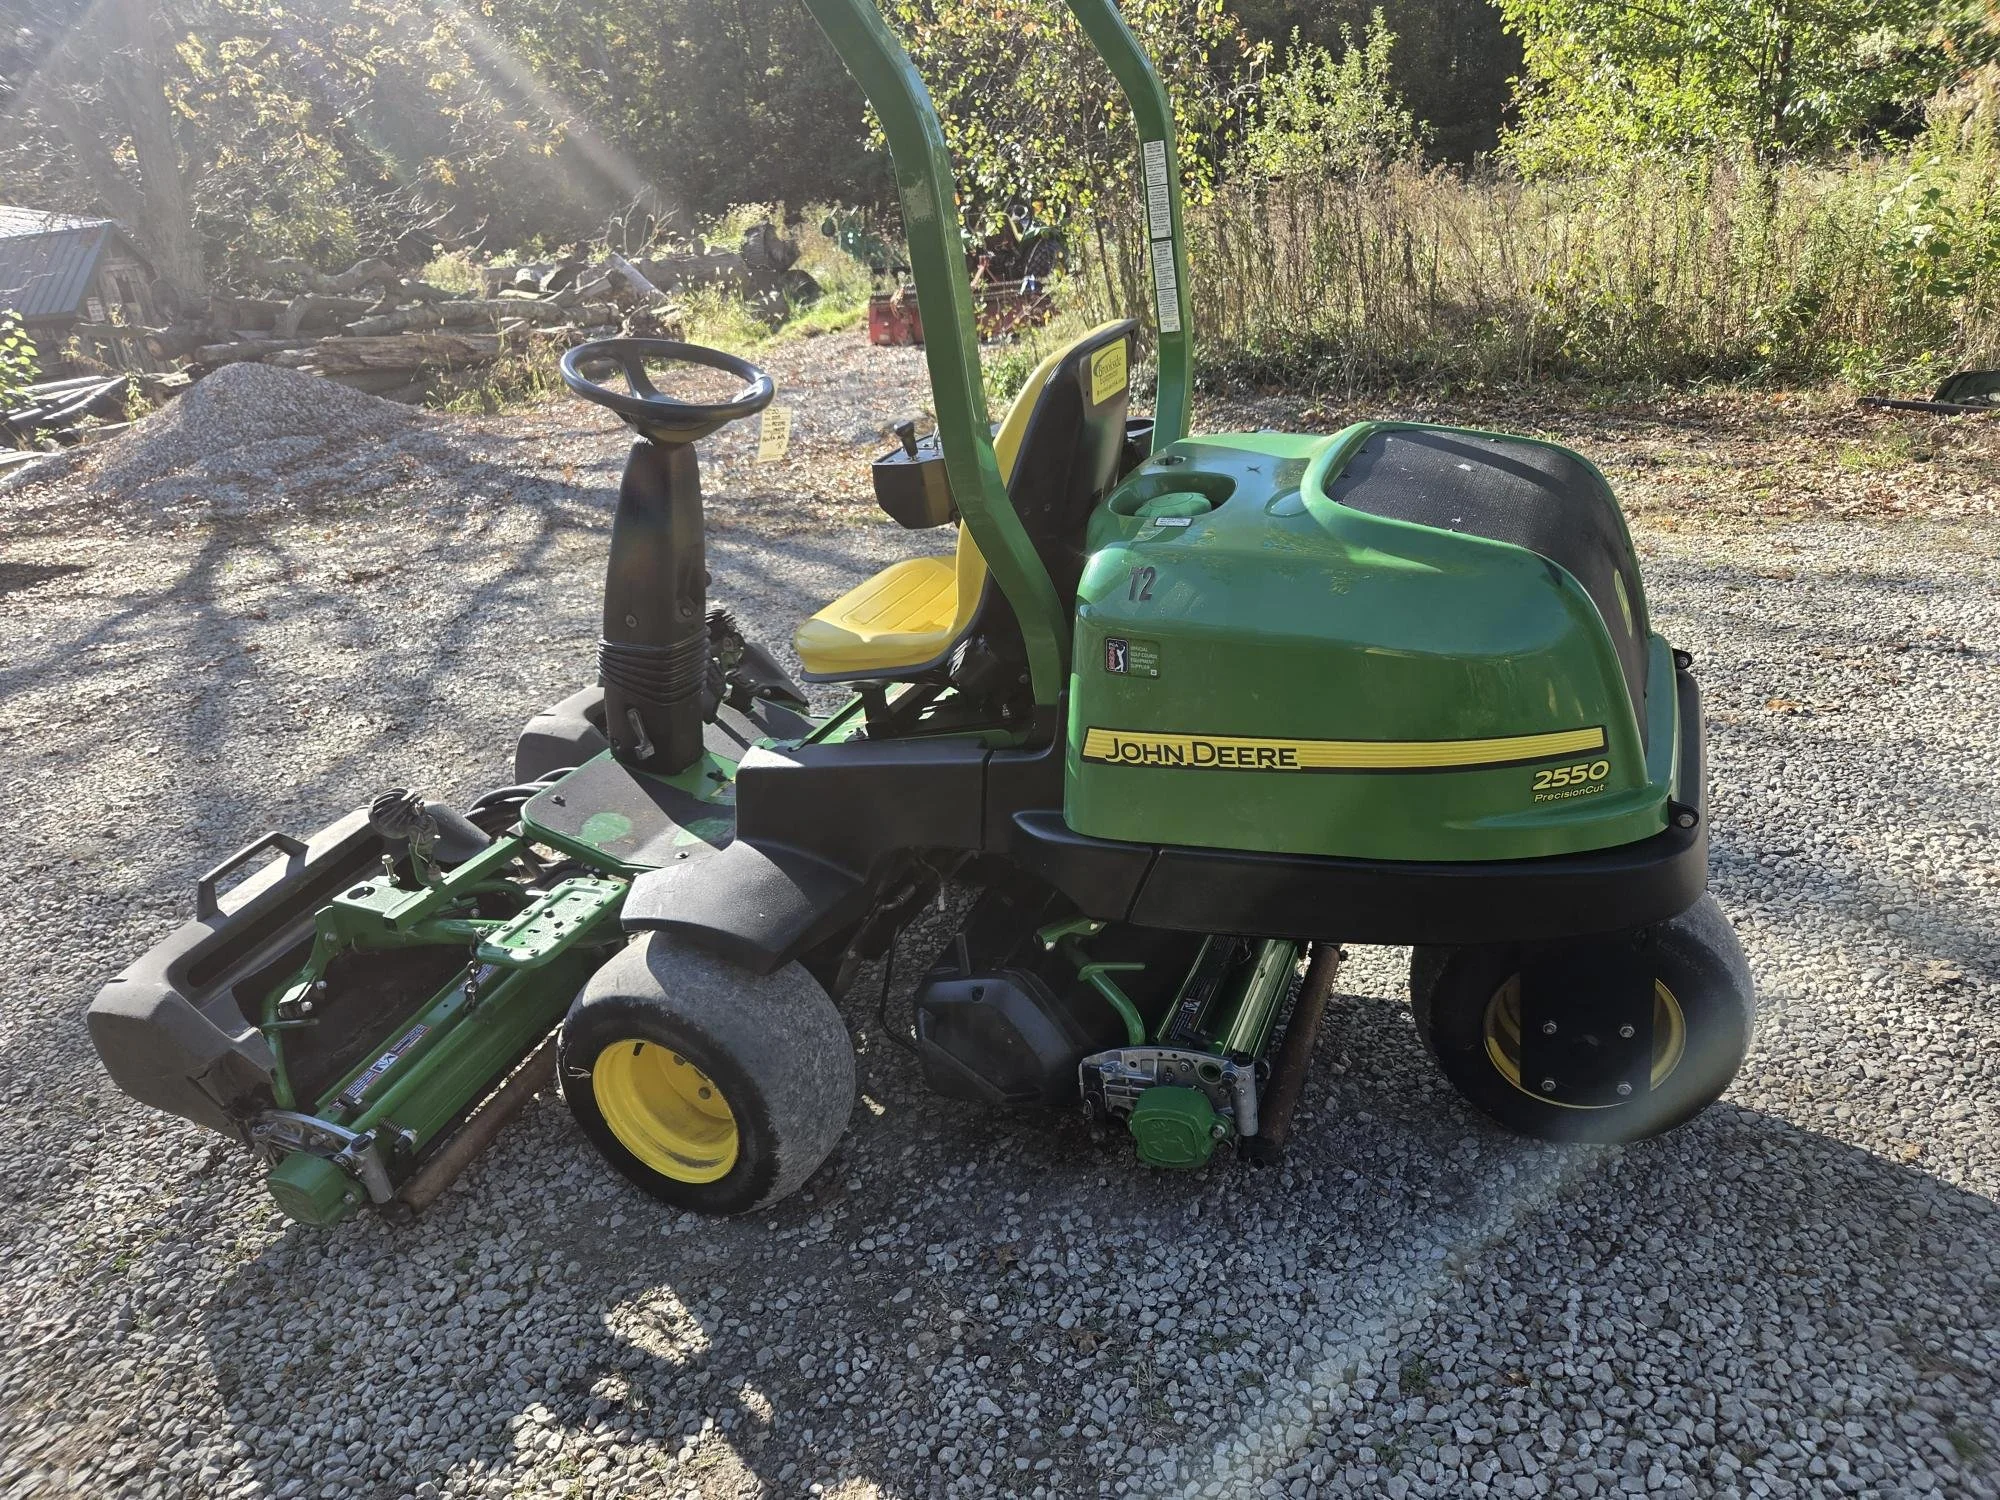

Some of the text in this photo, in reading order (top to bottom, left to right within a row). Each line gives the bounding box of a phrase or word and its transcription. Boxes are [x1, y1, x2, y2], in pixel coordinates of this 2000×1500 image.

[1105, 738, 1299, 767] JOHN DEERE
[1532, 760, 1610, 791] 2550
[1534, 783, 1606, 803] PrecisionCut
